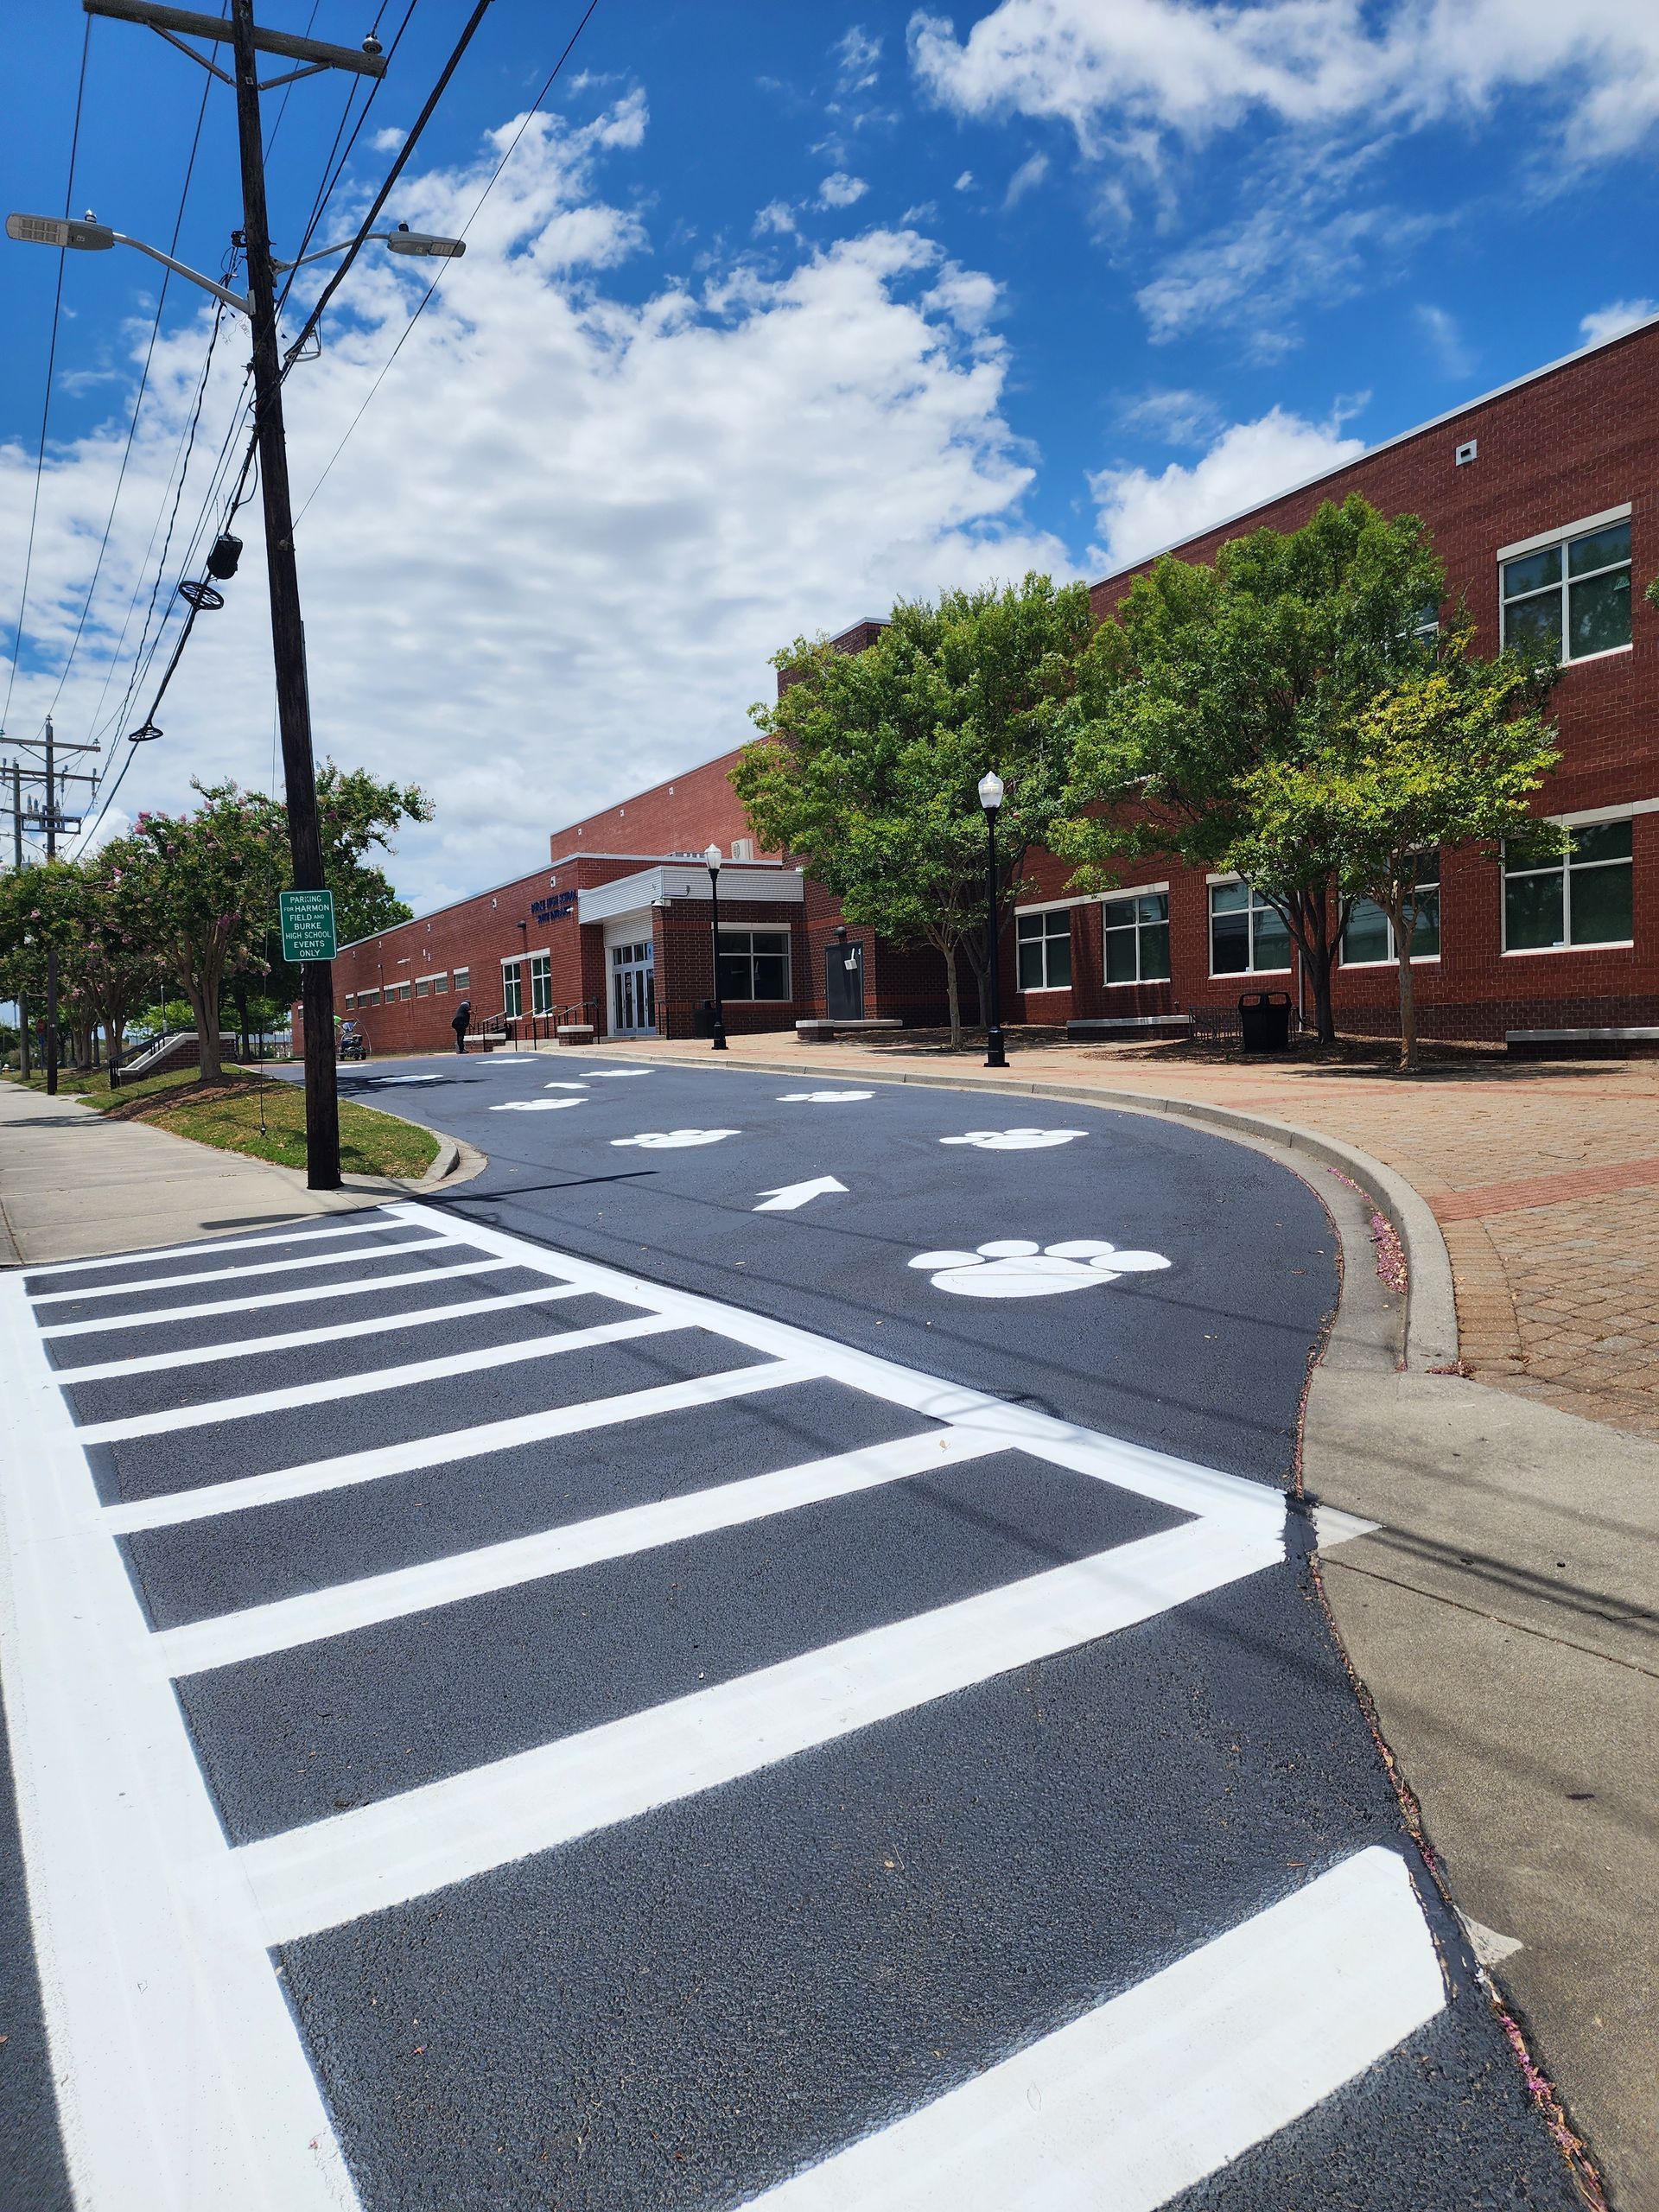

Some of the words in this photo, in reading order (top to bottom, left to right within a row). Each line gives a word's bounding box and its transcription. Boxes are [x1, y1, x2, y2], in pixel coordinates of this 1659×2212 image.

[289, 895, 321, 904] PARKING
[295, 904, 329, 912] HARMON
[294, 922, 321, 931] BURKE
[304, 931, 332, 939] SCHOOL
[294, 940, 325, 949] EVENTS
[299, 949, 321, 957] ONLY
